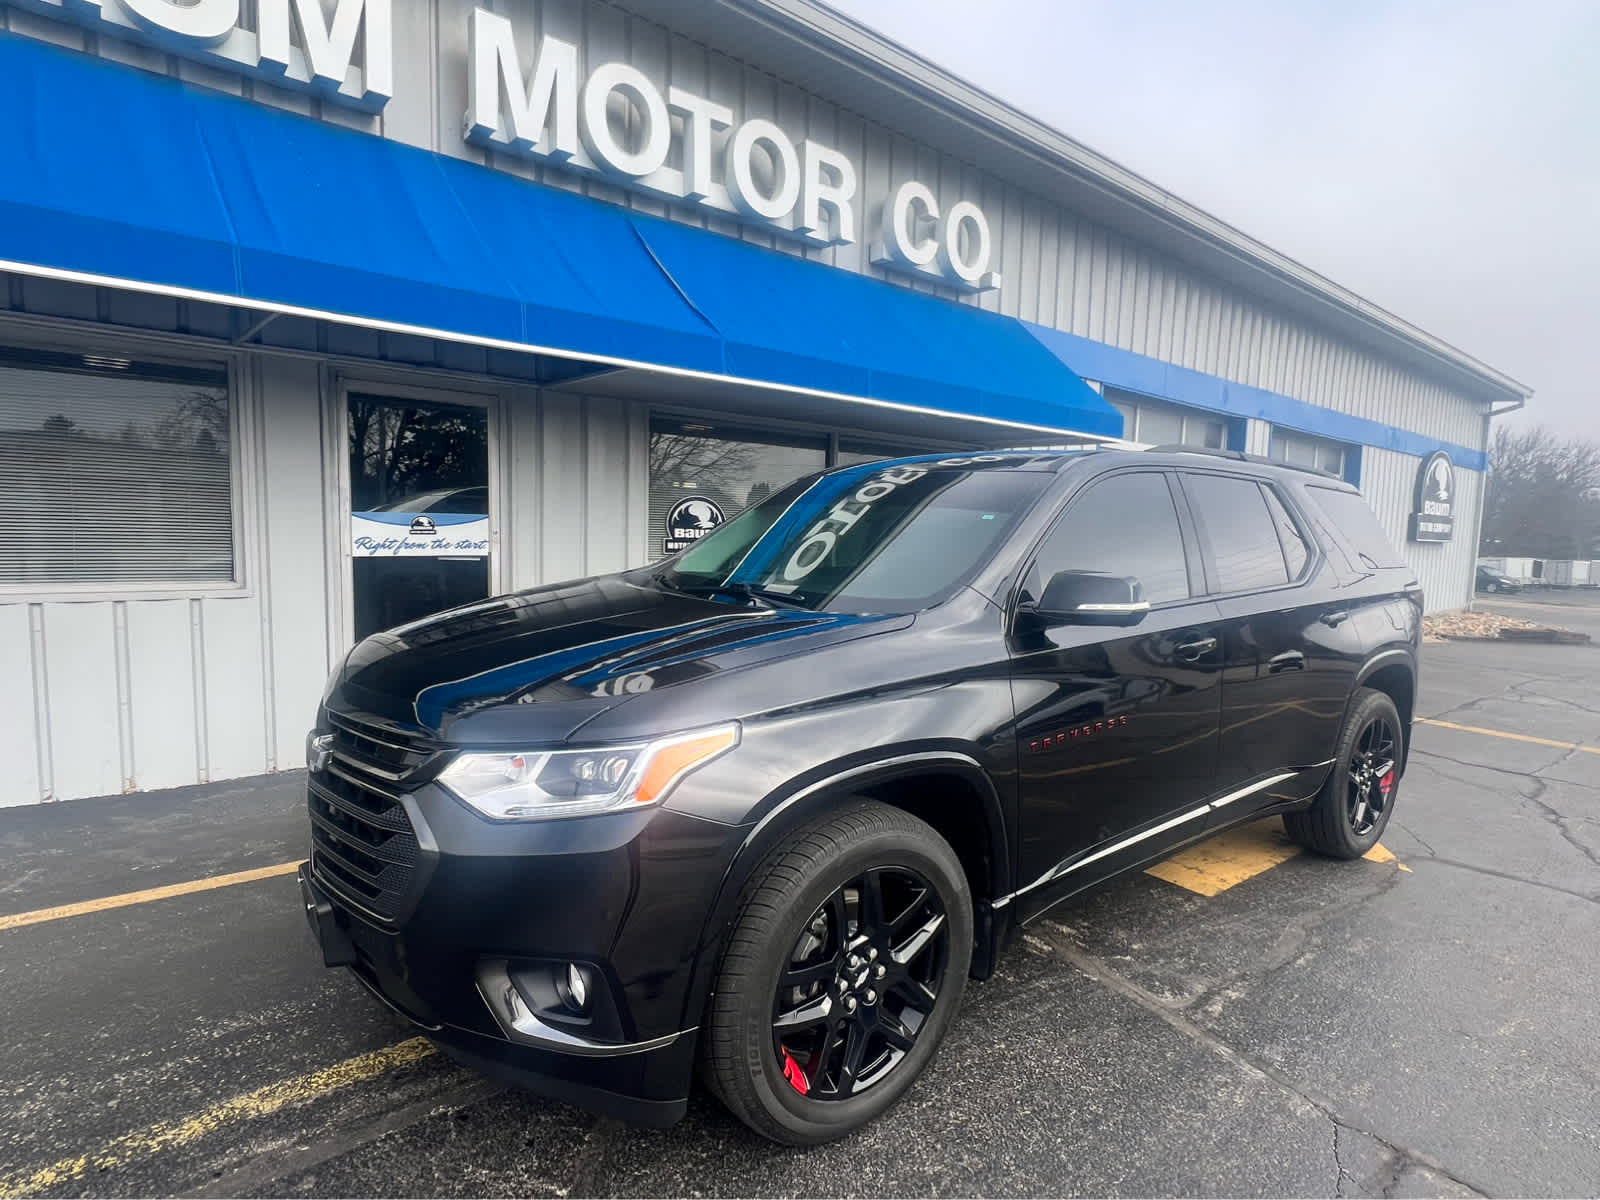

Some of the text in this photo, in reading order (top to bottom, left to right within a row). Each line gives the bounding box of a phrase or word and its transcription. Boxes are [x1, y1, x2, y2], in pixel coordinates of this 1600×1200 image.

[469, 7, 857, 245] MOTOR
[885, 181, 1001, 289] CO.
[354, 536, 399, 555] Right
[393, 537, 429, 555] from
[430, 538, 451, 550] the
